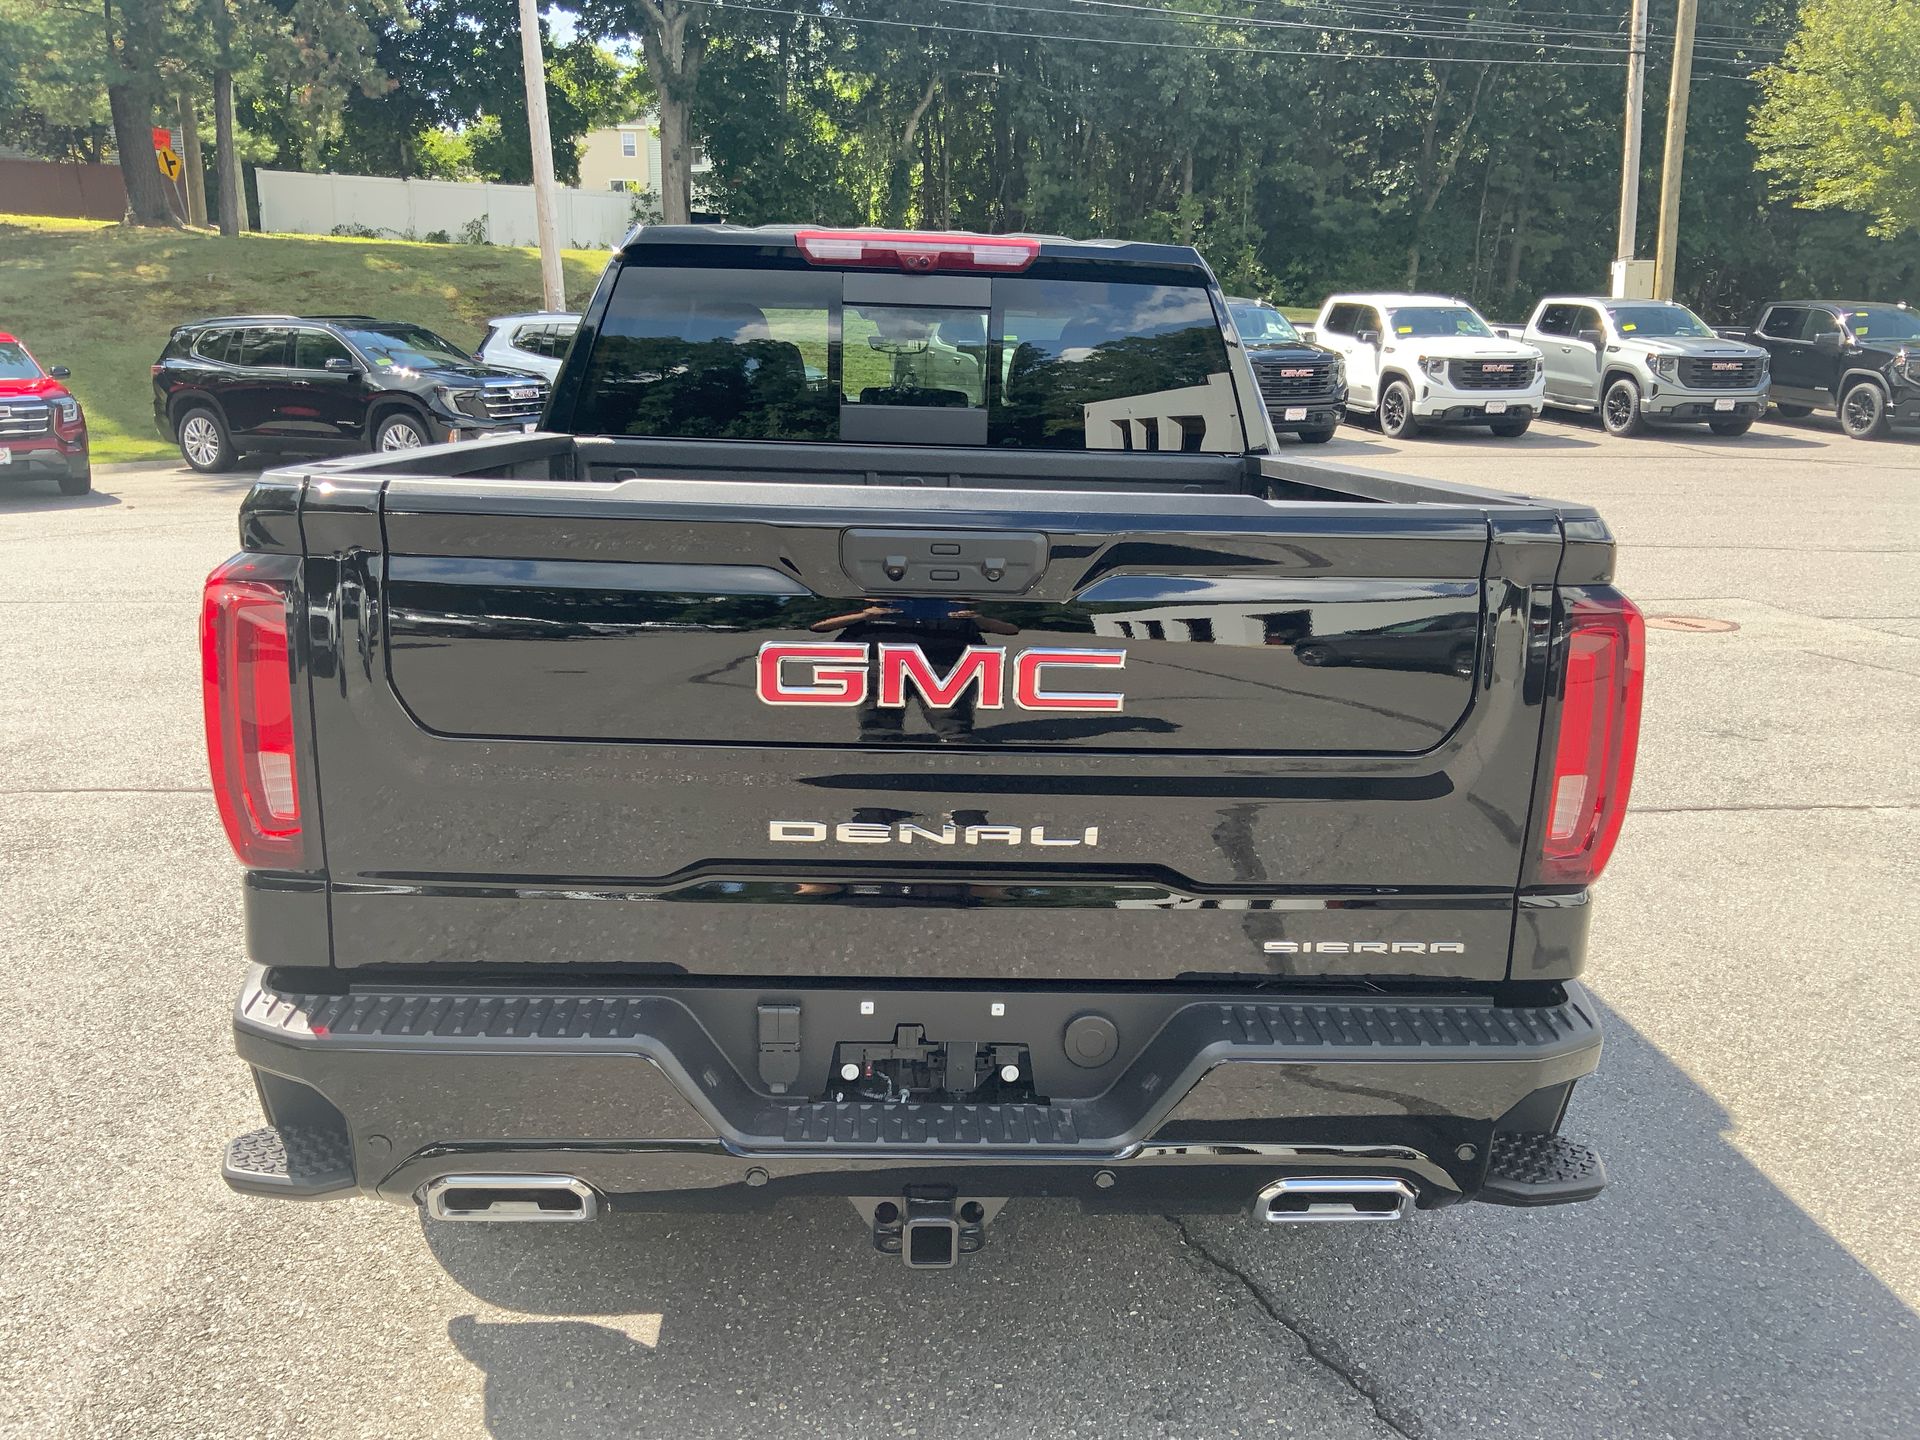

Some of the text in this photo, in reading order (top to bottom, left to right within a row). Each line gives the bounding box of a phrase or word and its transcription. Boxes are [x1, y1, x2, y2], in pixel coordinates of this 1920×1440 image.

[756, 641, 1127, 712] GMC
[769, 821, 1098, 846] DENALI
[1264, 942, 1464, 954] SIERRA
